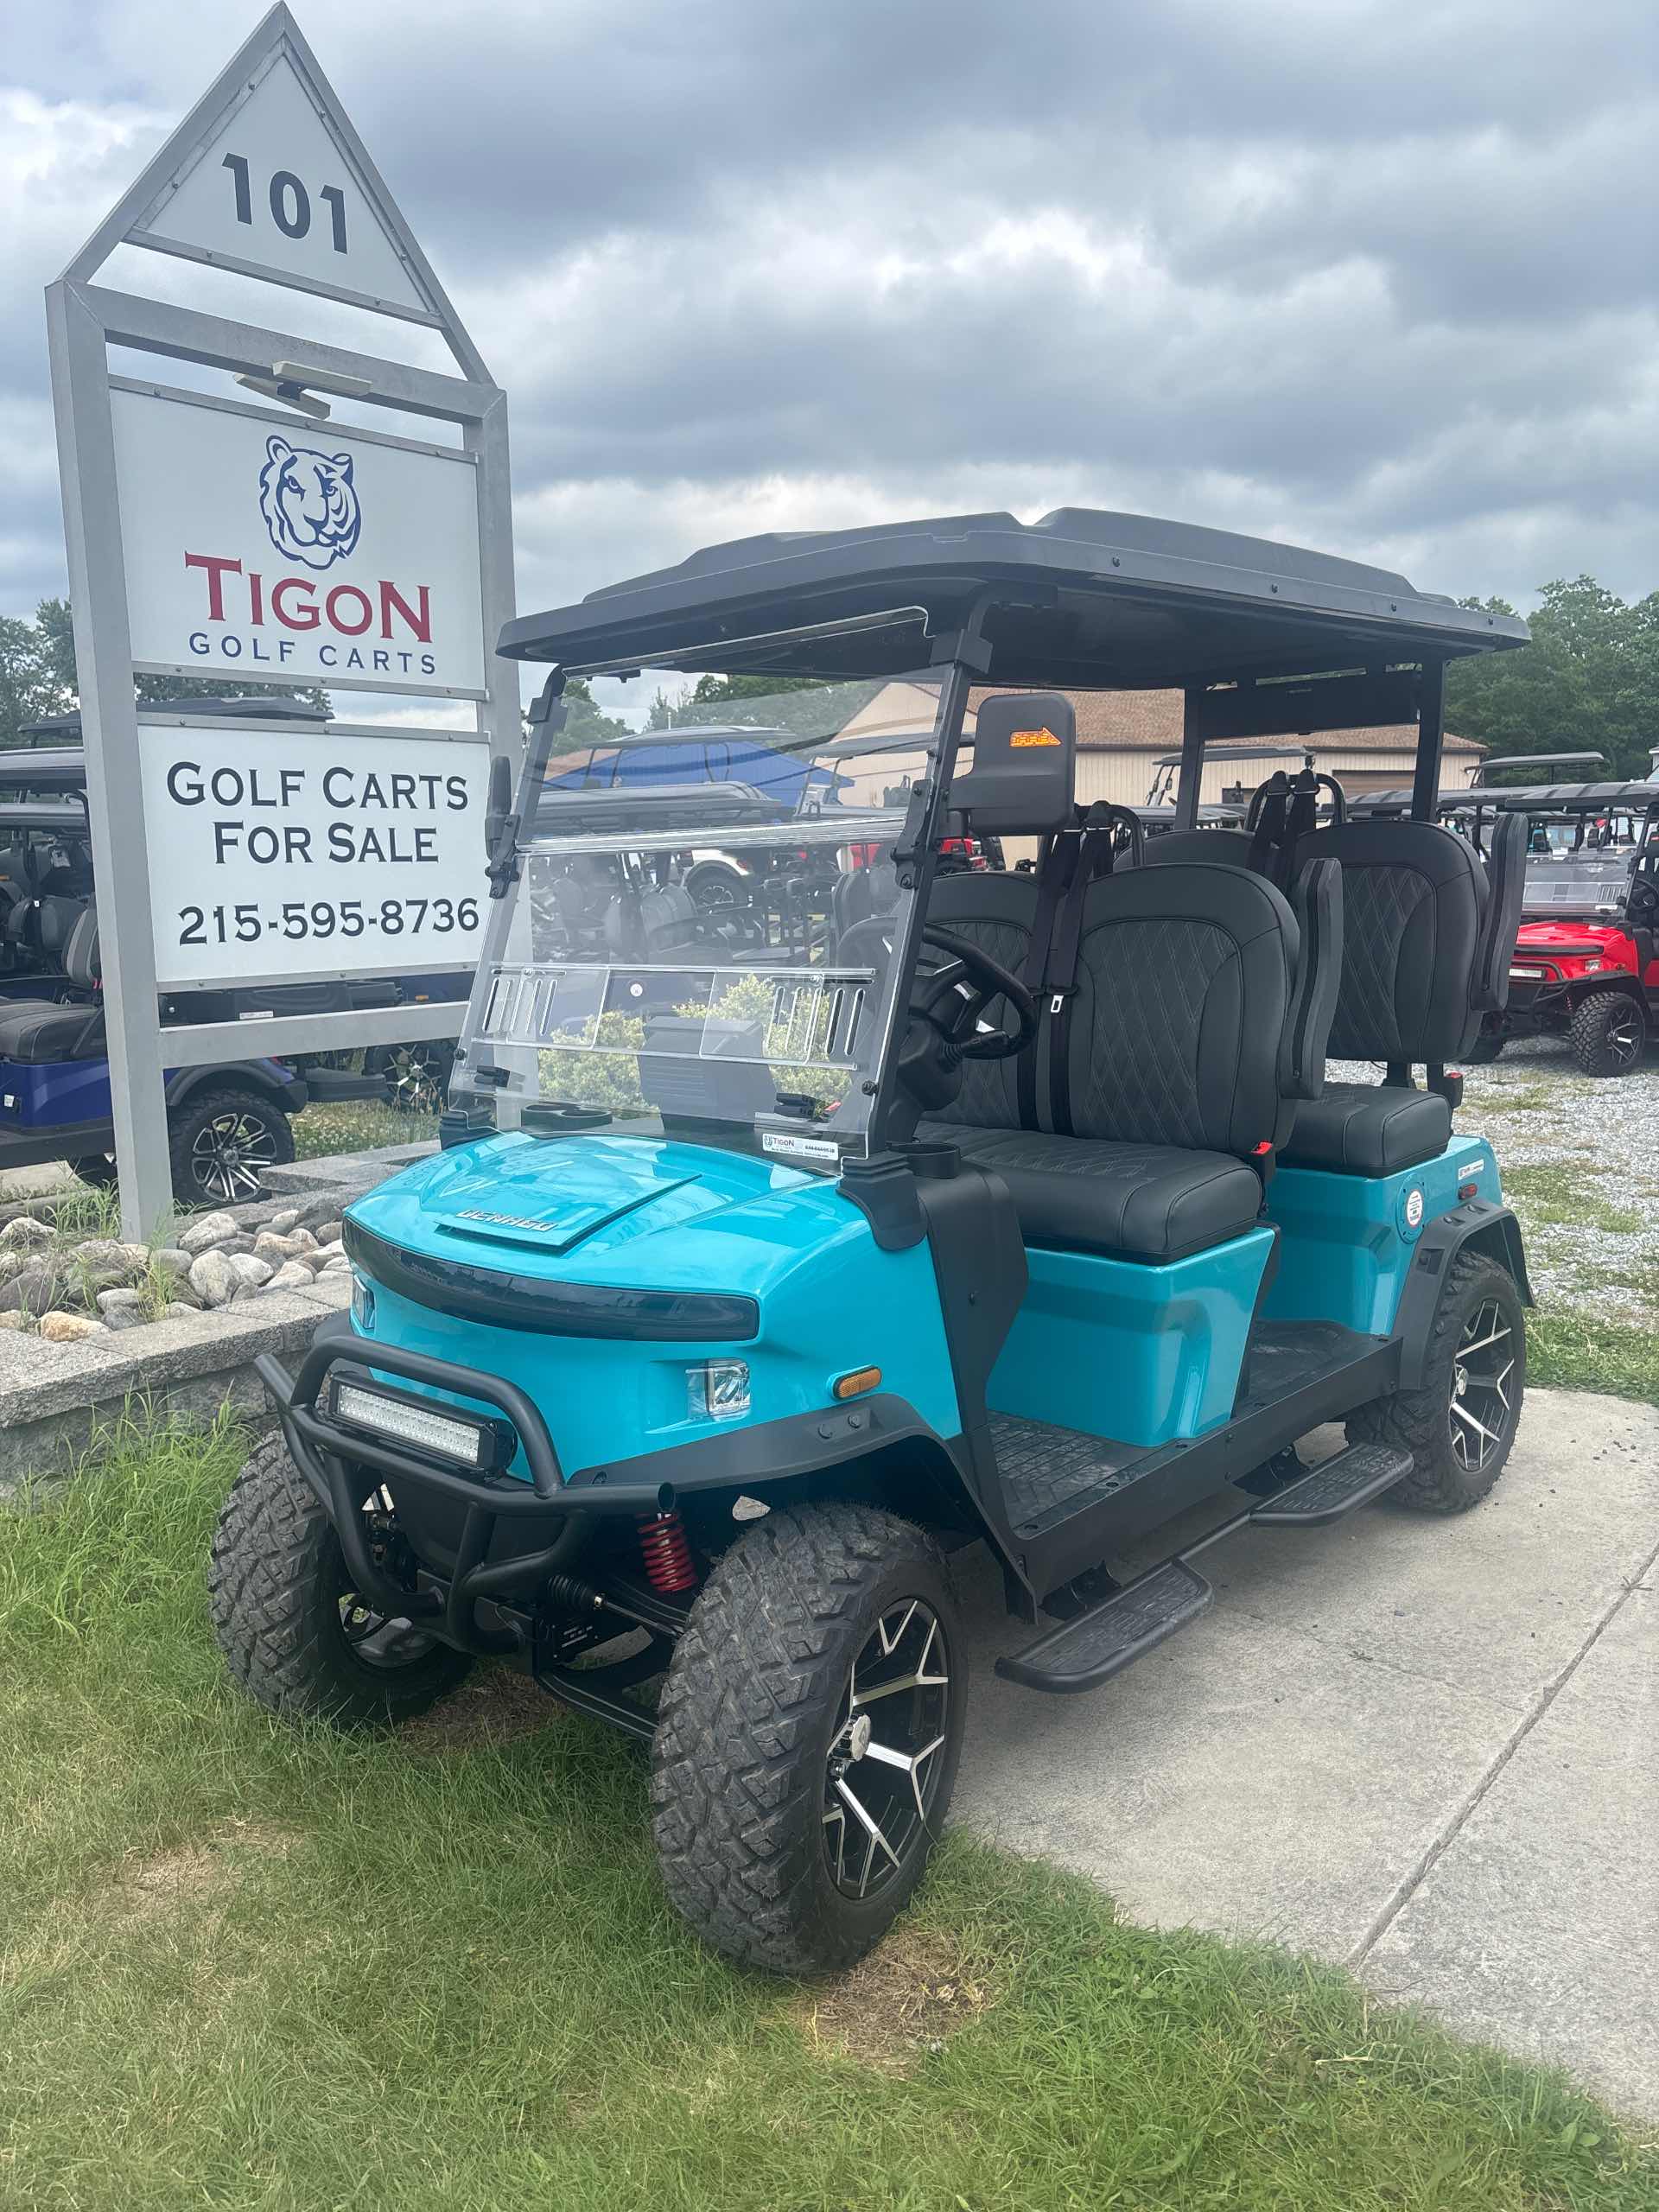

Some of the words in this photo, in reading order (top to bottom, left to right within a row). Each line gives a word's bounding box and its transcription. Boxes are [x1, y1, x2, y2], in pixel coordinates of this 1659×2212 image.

[222, 153, 347, 254] 101
[185, 552, 432, 643] TIGON
[188, 632, 296, 663] GOLF
[319, 645, 435, 675] CARTS
[167, 761, 305, 807] GOLF
[322, 766, 468, 810] CARTS
[213, 820, 314, 864] FOR
[327, 822, 439, 863] SALE
[177, 898, 480, 947] 215-595-8736
